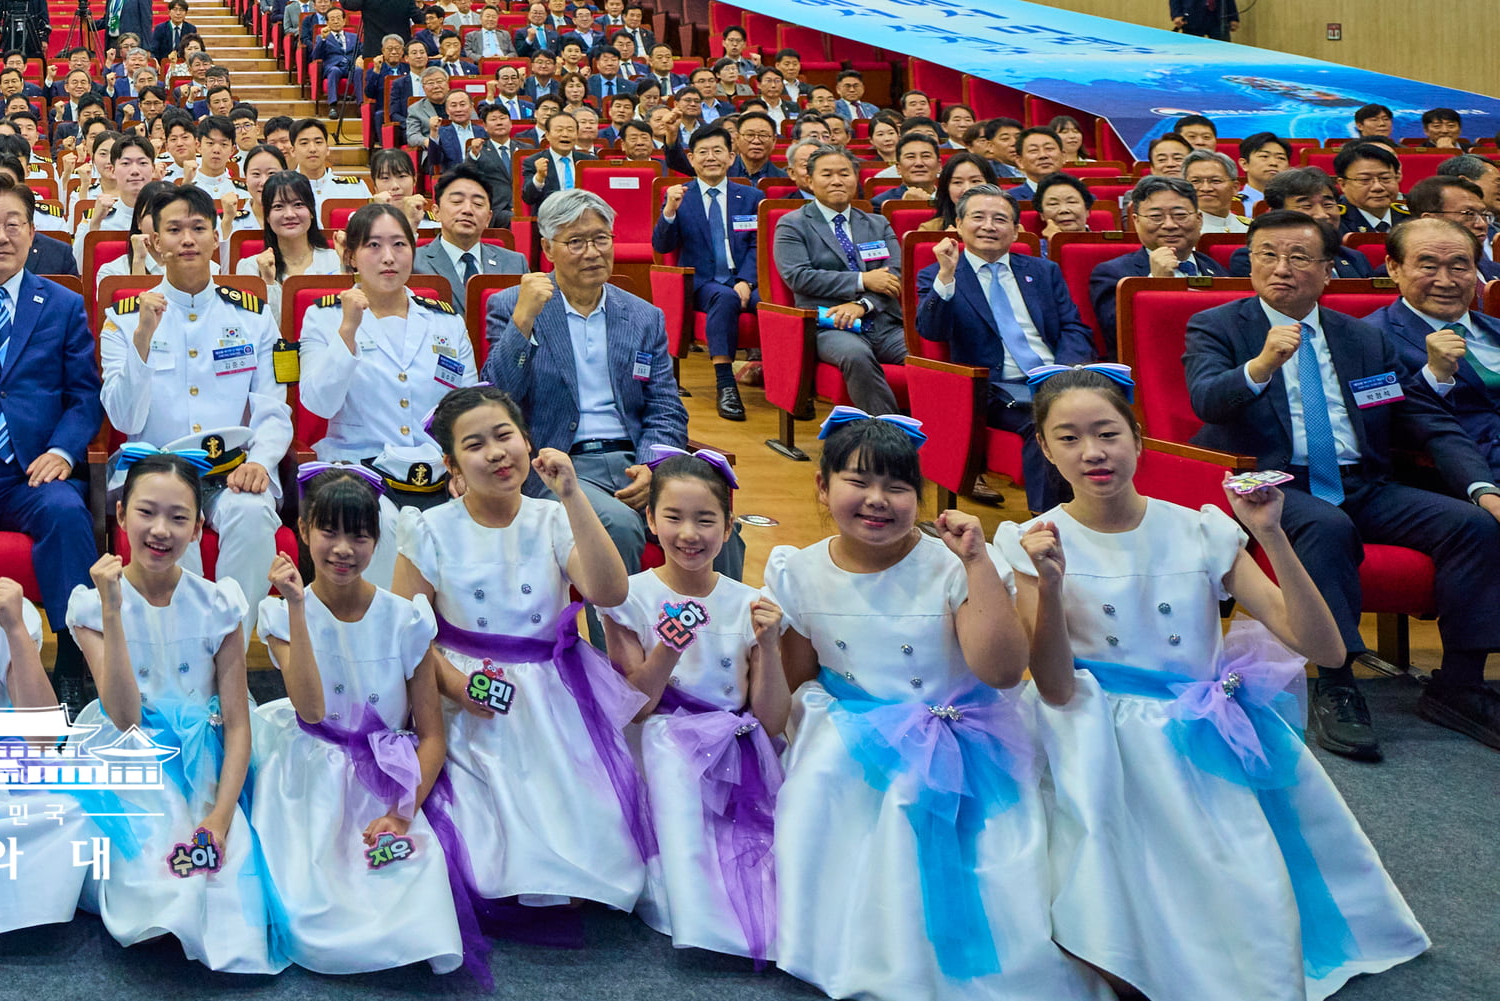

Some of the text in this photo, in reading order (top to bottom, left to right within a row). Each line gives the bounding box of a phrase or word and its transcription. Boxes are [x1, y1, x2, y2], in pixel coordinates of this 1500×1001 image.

[660, 603, 705, 645] 단아
[470, 674, 512, 710] 유민
[172, 845, 216, 875] 수아
[369, 840, 411, 866] 지우
